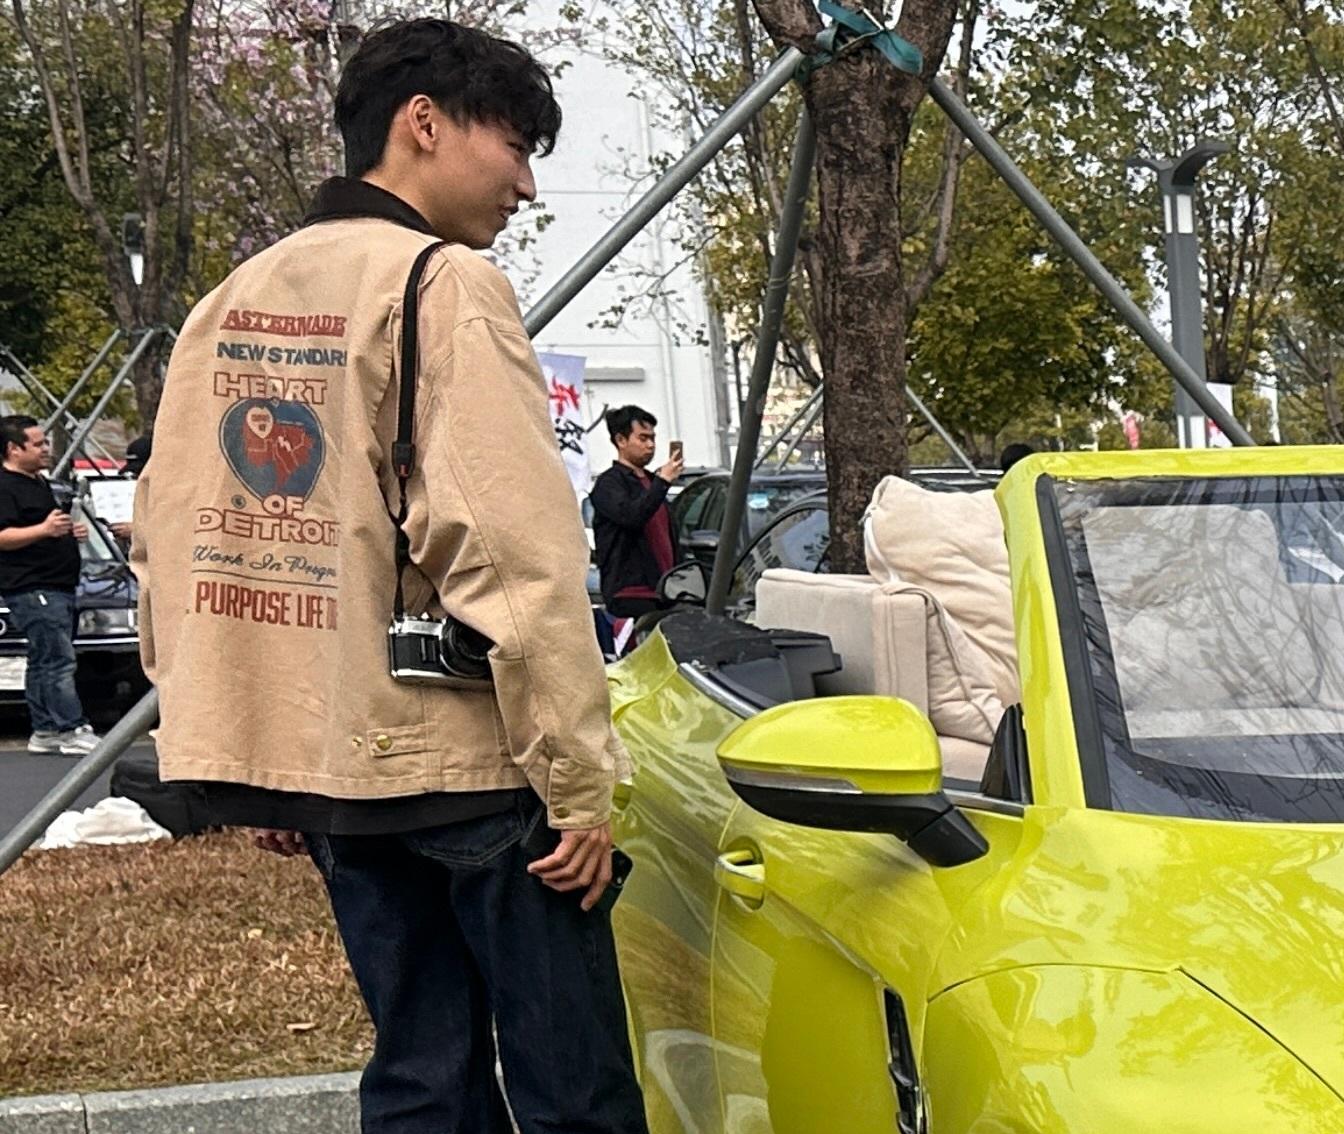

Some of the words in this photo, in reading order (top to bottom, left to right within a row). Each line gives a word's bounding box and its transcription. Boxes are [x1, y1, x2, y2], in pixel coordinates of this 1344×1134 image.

[220, 309, 348, 338] ASTERMADE
[216, 342, 266, 361] NEW
[214, 371, 328, 405] HEART
[262, 493, 305, 517] OF
[193, 544, 245, 567] Work
[249, 553, 284, 572] In
[195, 580, 293, 627] PURPOSE
[296, 594, 324, 630] LIFE
